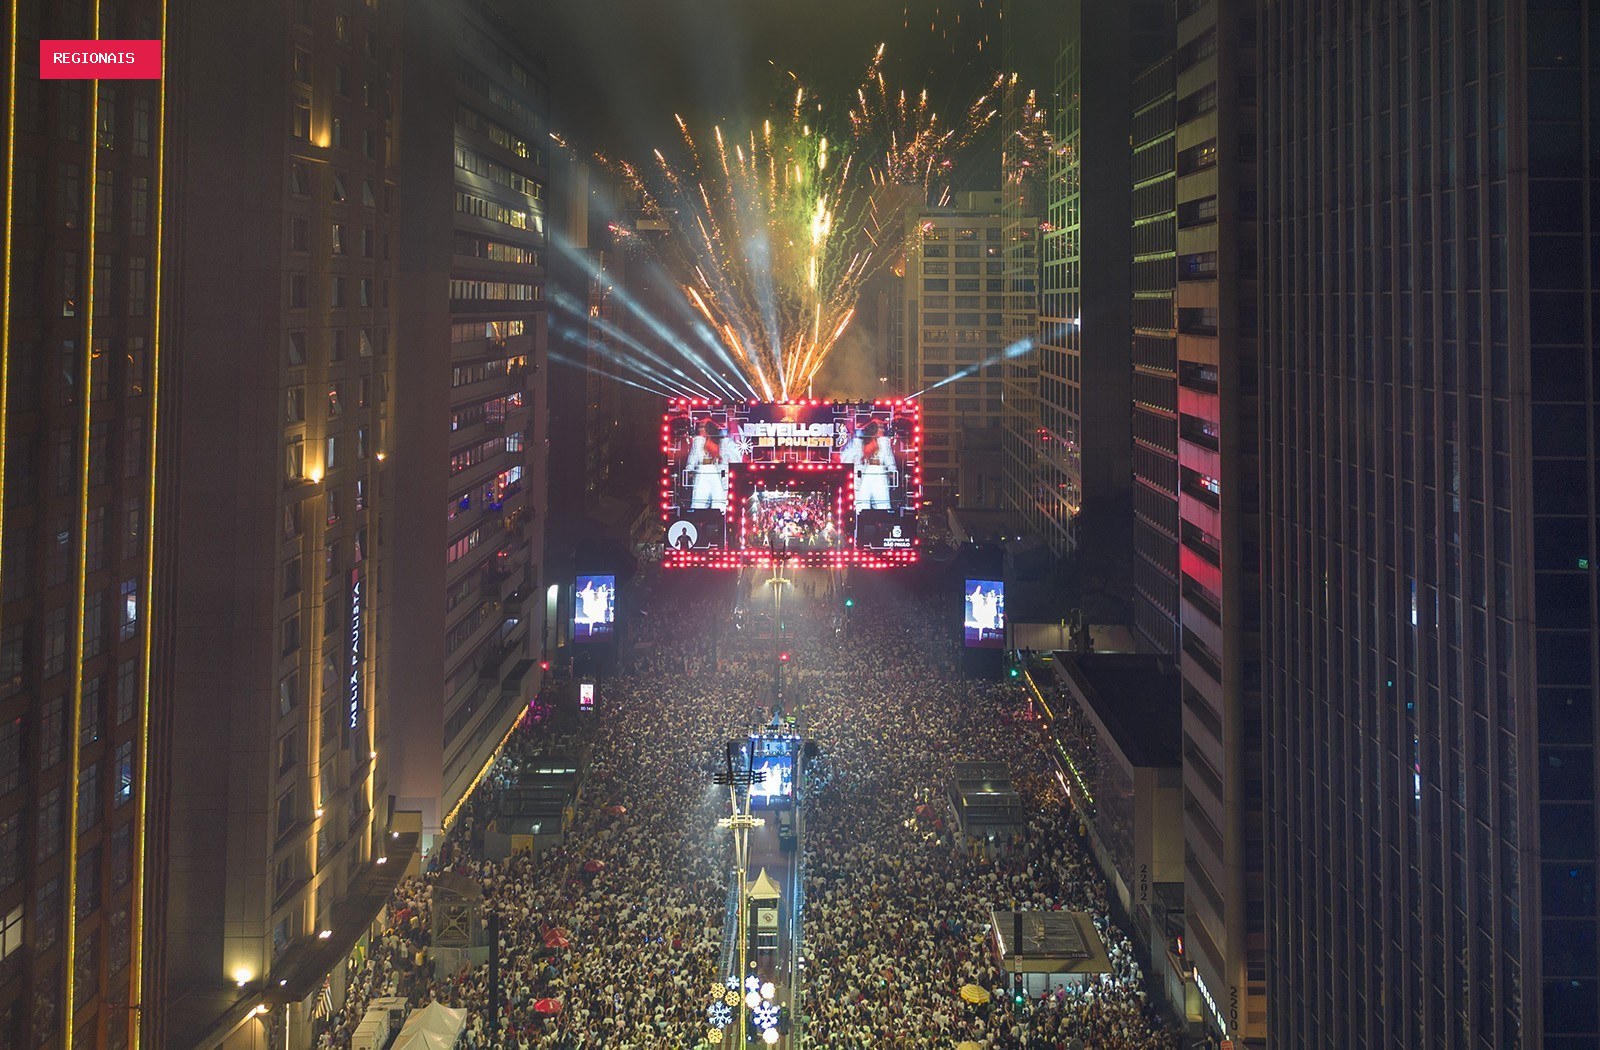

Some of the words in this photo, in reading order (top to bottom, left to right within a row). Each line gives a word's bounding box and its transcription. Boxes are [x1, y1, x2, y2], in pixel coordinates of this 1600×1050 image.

[743, 420, 834, 436] RÉVEILLON
[352, 582, 360, 665] PAULISTA
[1230, 986, 1239, 1031] 2200
